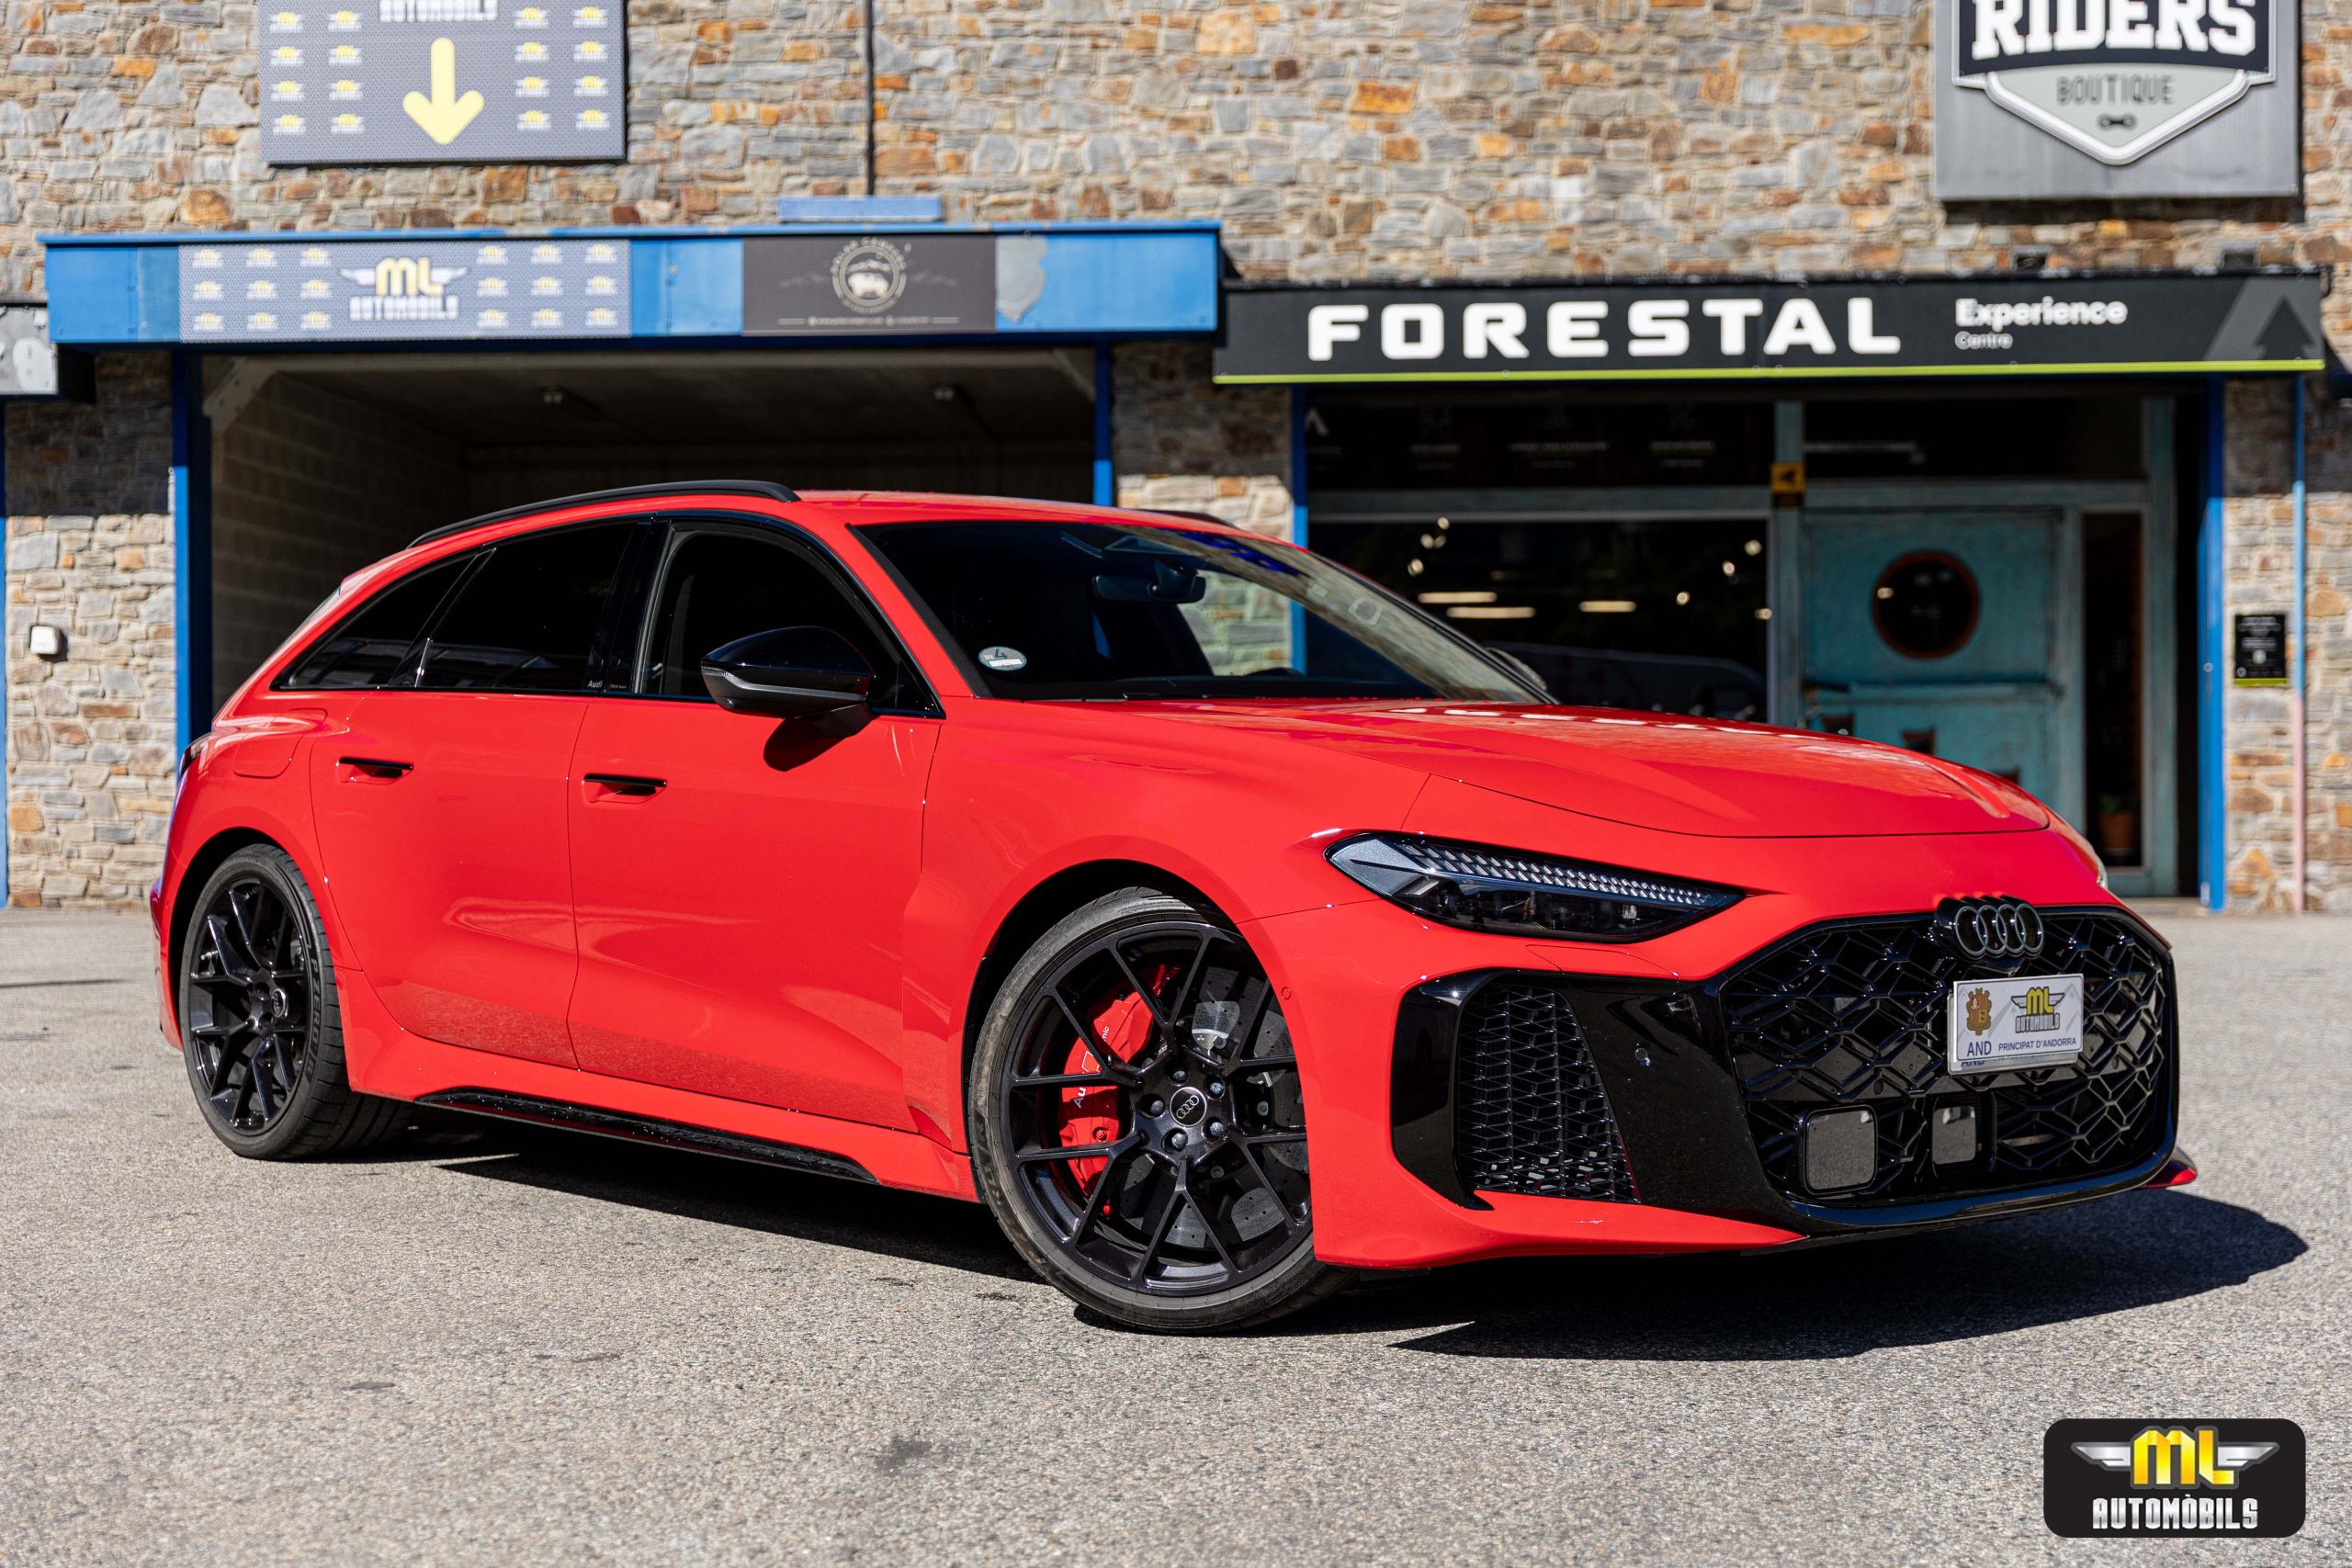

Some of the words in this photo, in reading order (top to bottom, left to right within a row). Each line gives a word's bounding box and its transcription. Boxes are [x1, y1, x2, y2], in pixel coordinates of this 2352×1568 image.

[1972, 0, 2256, 60] RIDERS
[2056, 73, 2176, 106] BOUTIQUE
[375, 257, 444, 296] ML
[1307, 297, 1902, 362] FORESTAL
[1955, 295, 2128, 333] Experience
[2027, 987, 2054, 1015] ML
[1967, 1041, 1992, 1057] AND
[1998, 1040, 2034, 1052] PRINCIPAT
[2035, 1037, 2076, 1049] D'ANDORRA
